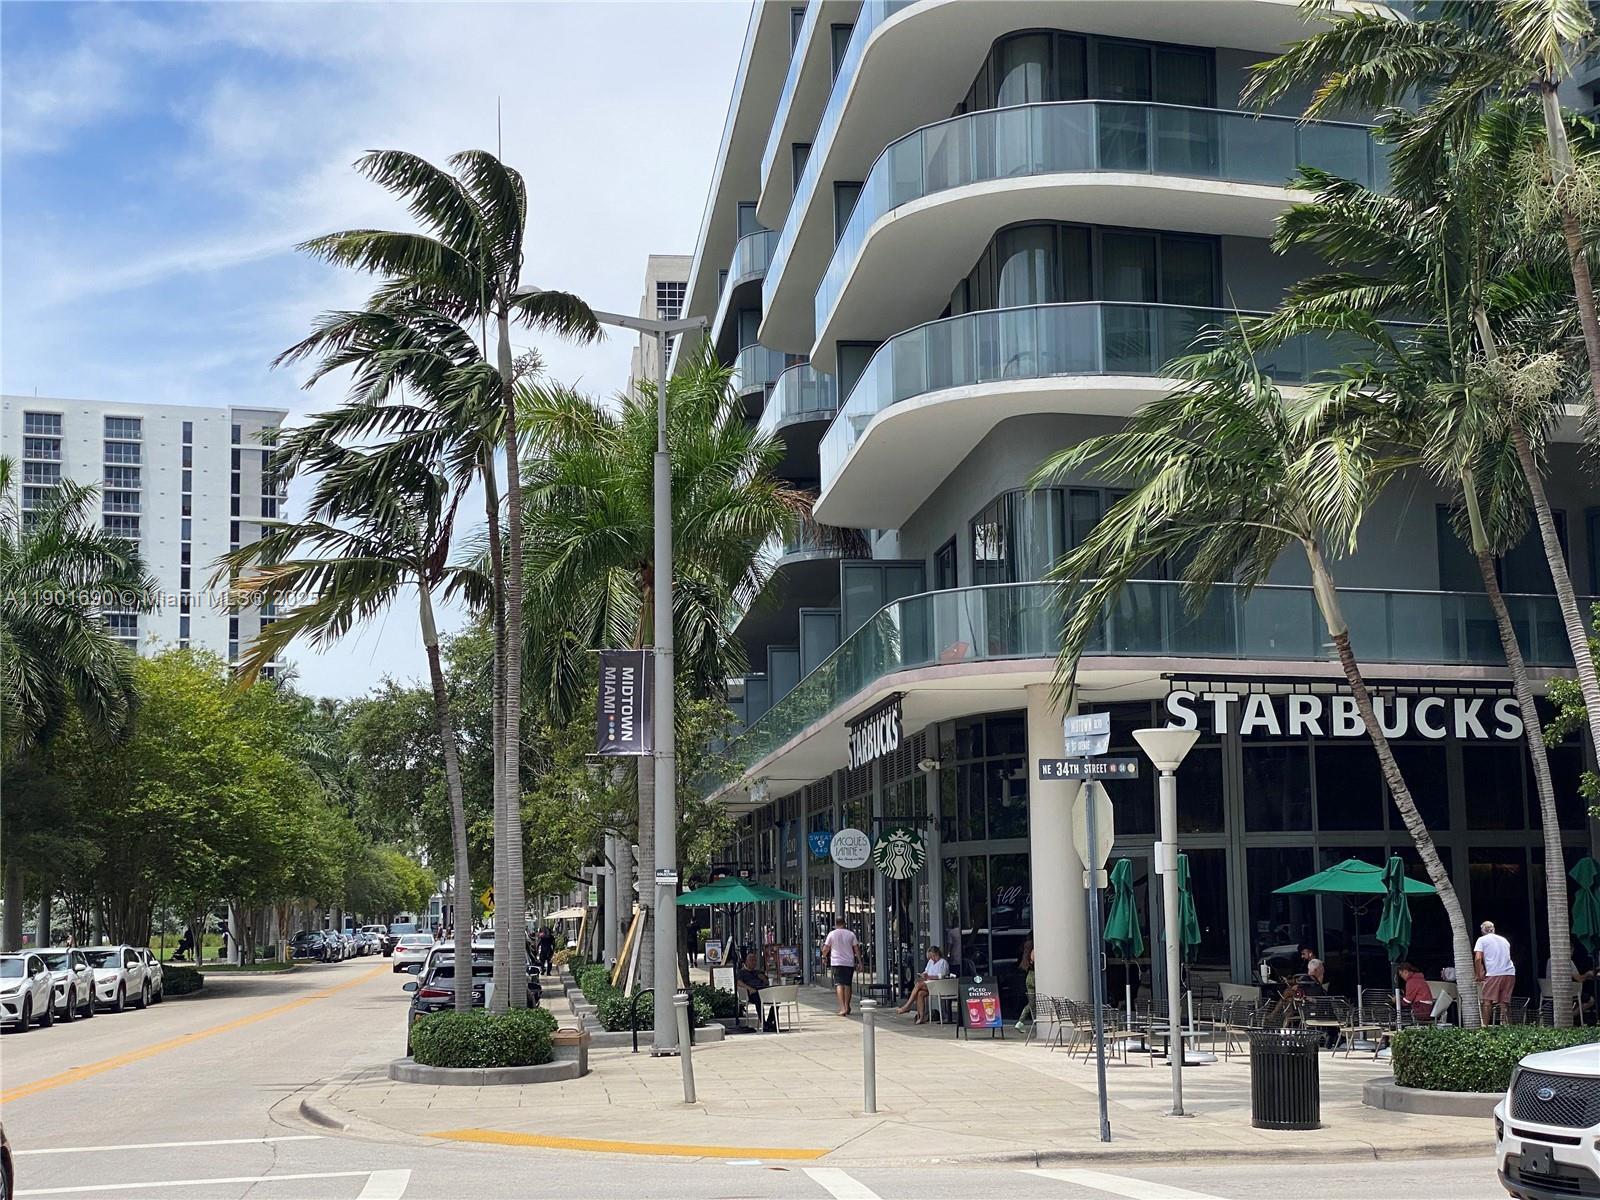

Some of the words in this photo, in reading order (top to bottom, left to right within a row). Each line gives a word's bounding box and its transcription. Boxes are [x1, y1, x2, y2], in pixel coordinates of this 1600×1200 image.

[604, 667, 616, 714] MIAMI
[621, 667, 634, 741] MIDTOWN
[1166, 690, 1523, 739] STARBUCKS
[848, 709, 898, 771] STARBUCKS
[1042, 764, 1051, 775] NE
[1056, 762, 1079, 776] 34TH
[1084, 763, 1107, 774] STREET
[834, 836, 867, 847] JACQUES
